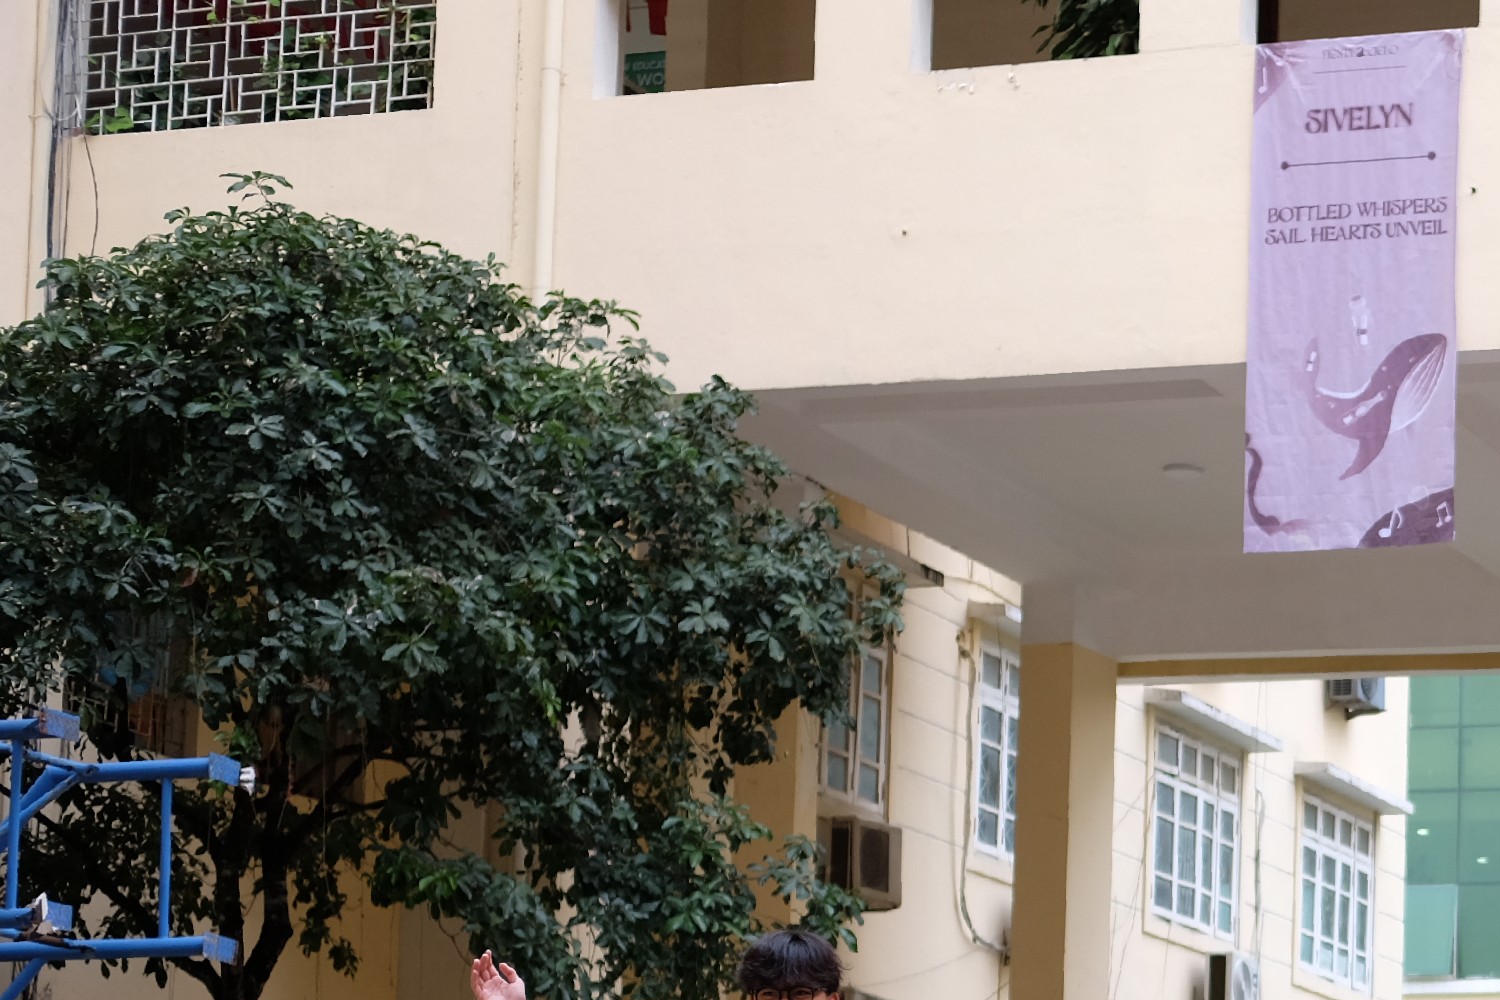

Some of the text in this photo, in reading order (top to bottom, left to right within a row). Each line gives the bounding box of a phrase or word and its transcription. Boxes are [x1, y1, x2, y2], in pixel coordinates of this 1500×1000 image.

[1304, 102, 1414, 134] SIVELYN
[1267, 196, 1448, 223] BOTTLED WHISPERS
[1311, 222, 1382, 243] HEARTS
[1385, 219, 1447, 238] UNVEIL
